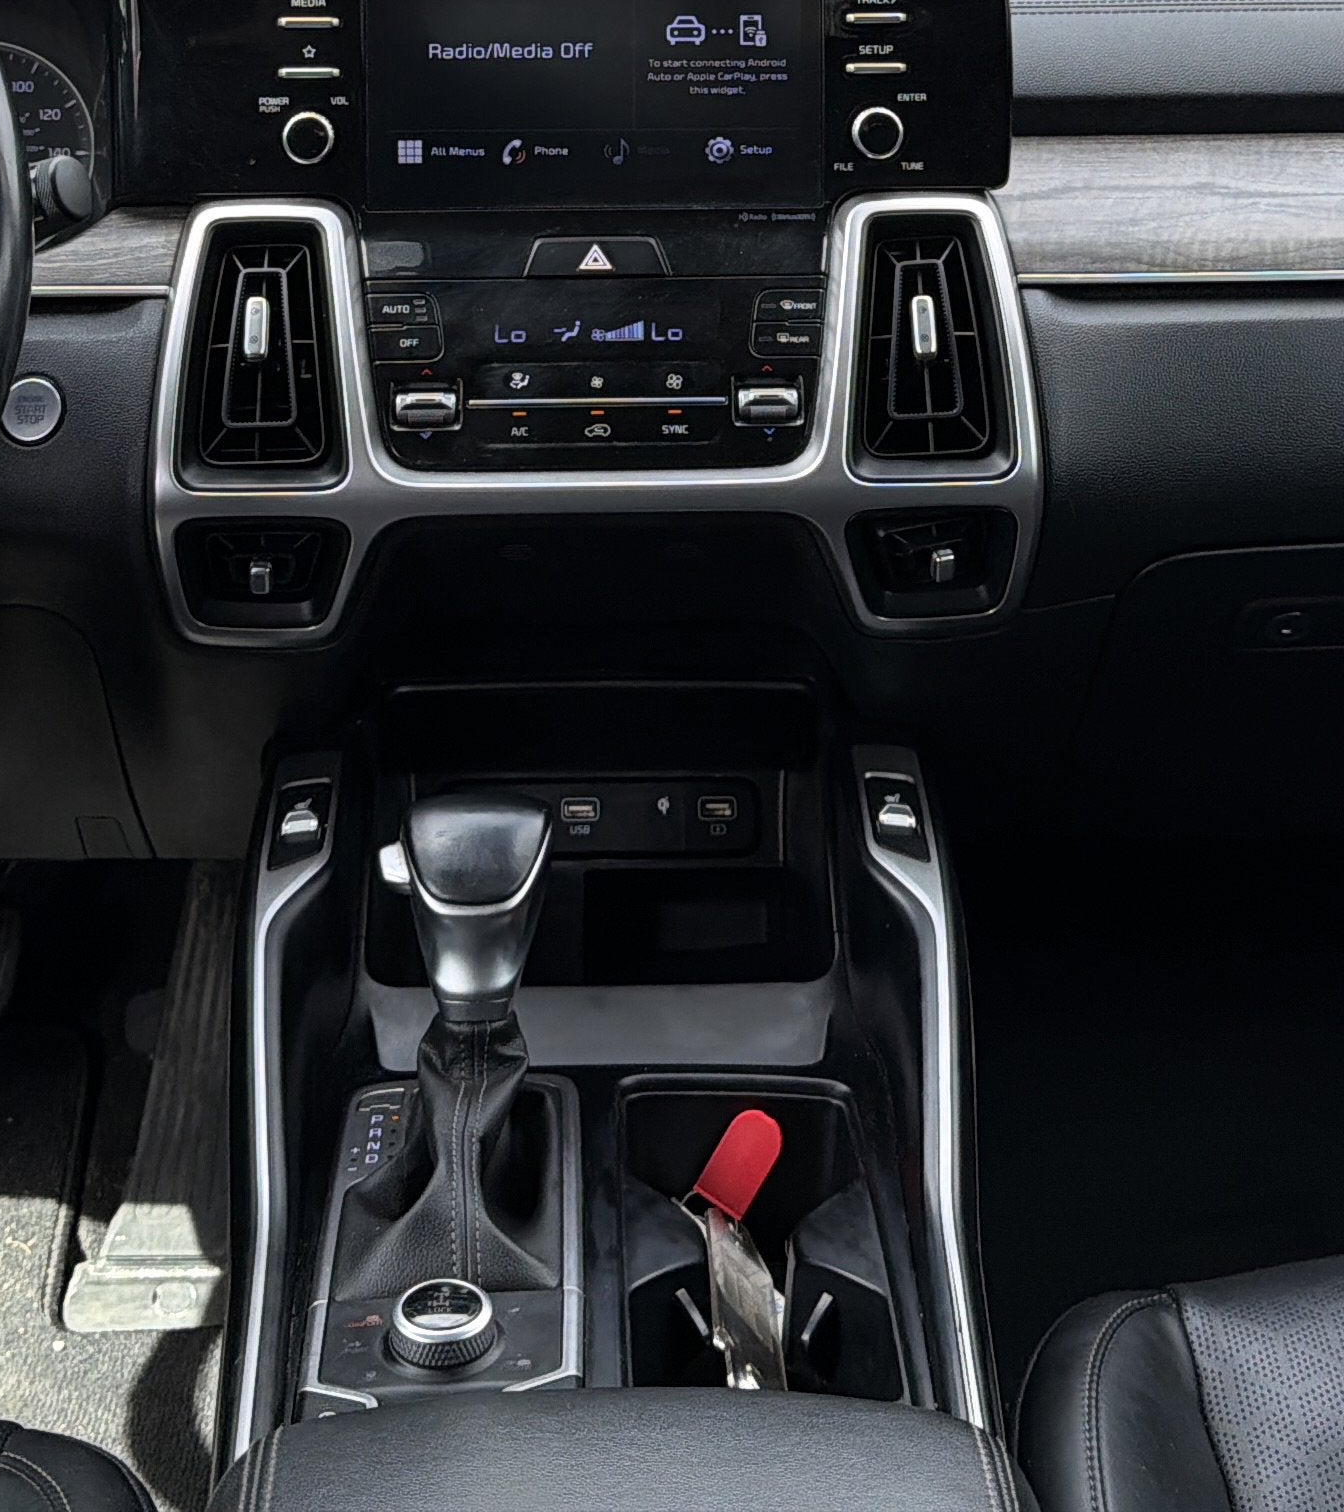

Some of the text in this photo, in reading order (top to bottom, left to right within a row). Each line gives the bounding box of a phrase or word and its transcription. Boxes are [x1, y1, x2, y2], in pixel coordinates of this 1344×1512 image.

[428, 42, 594, 60] Radio/Media Off
[859, 45, 893, 55] SETUP
[648, 58, 787, 69] To start connecting Android
[647, 72, 672, 81] Auto
[687, 72, 716, 82] Apple
[759, 73, 788, 83] press
[11, 80, 35, 93] 100
[689, 86, 708, 95] this
[258, 96, 289, 105] POWER
[330, 96, 349, 105] VOL
[897, 93, 927, 102] ENTER
[38, 108, 62, 121] 120
[47, 147, 71, 157] 140
[430, 146, 485, 157] All Menus
[534, 145, 569, 156] Phone
[740, 145, 773, 157] Setup
[834, 162, 854, 171] FILE
[901, 162, 924, 170] TUNE
[382, 304, 410, 314] AUTO
[793, 302, 817, 310] FRONT
[494, 323, 527, 343] Lo
[651, 322, 684, 342] Lo
[399, 338, 419, 348] OFF
[789, 335, 810, 343] REAR
[14, 404, 48, 415] START
[16, 414, 44, 425] STOP
[511, 426, 529, 437] A/C
[661, 424, 689, 435] SYNC
[569, 824, 591, 835] USB
[370, 1114, 384, 1124] P
[366, 1141, 381, 1151] N
[365, 1153, 379, 1164] D
